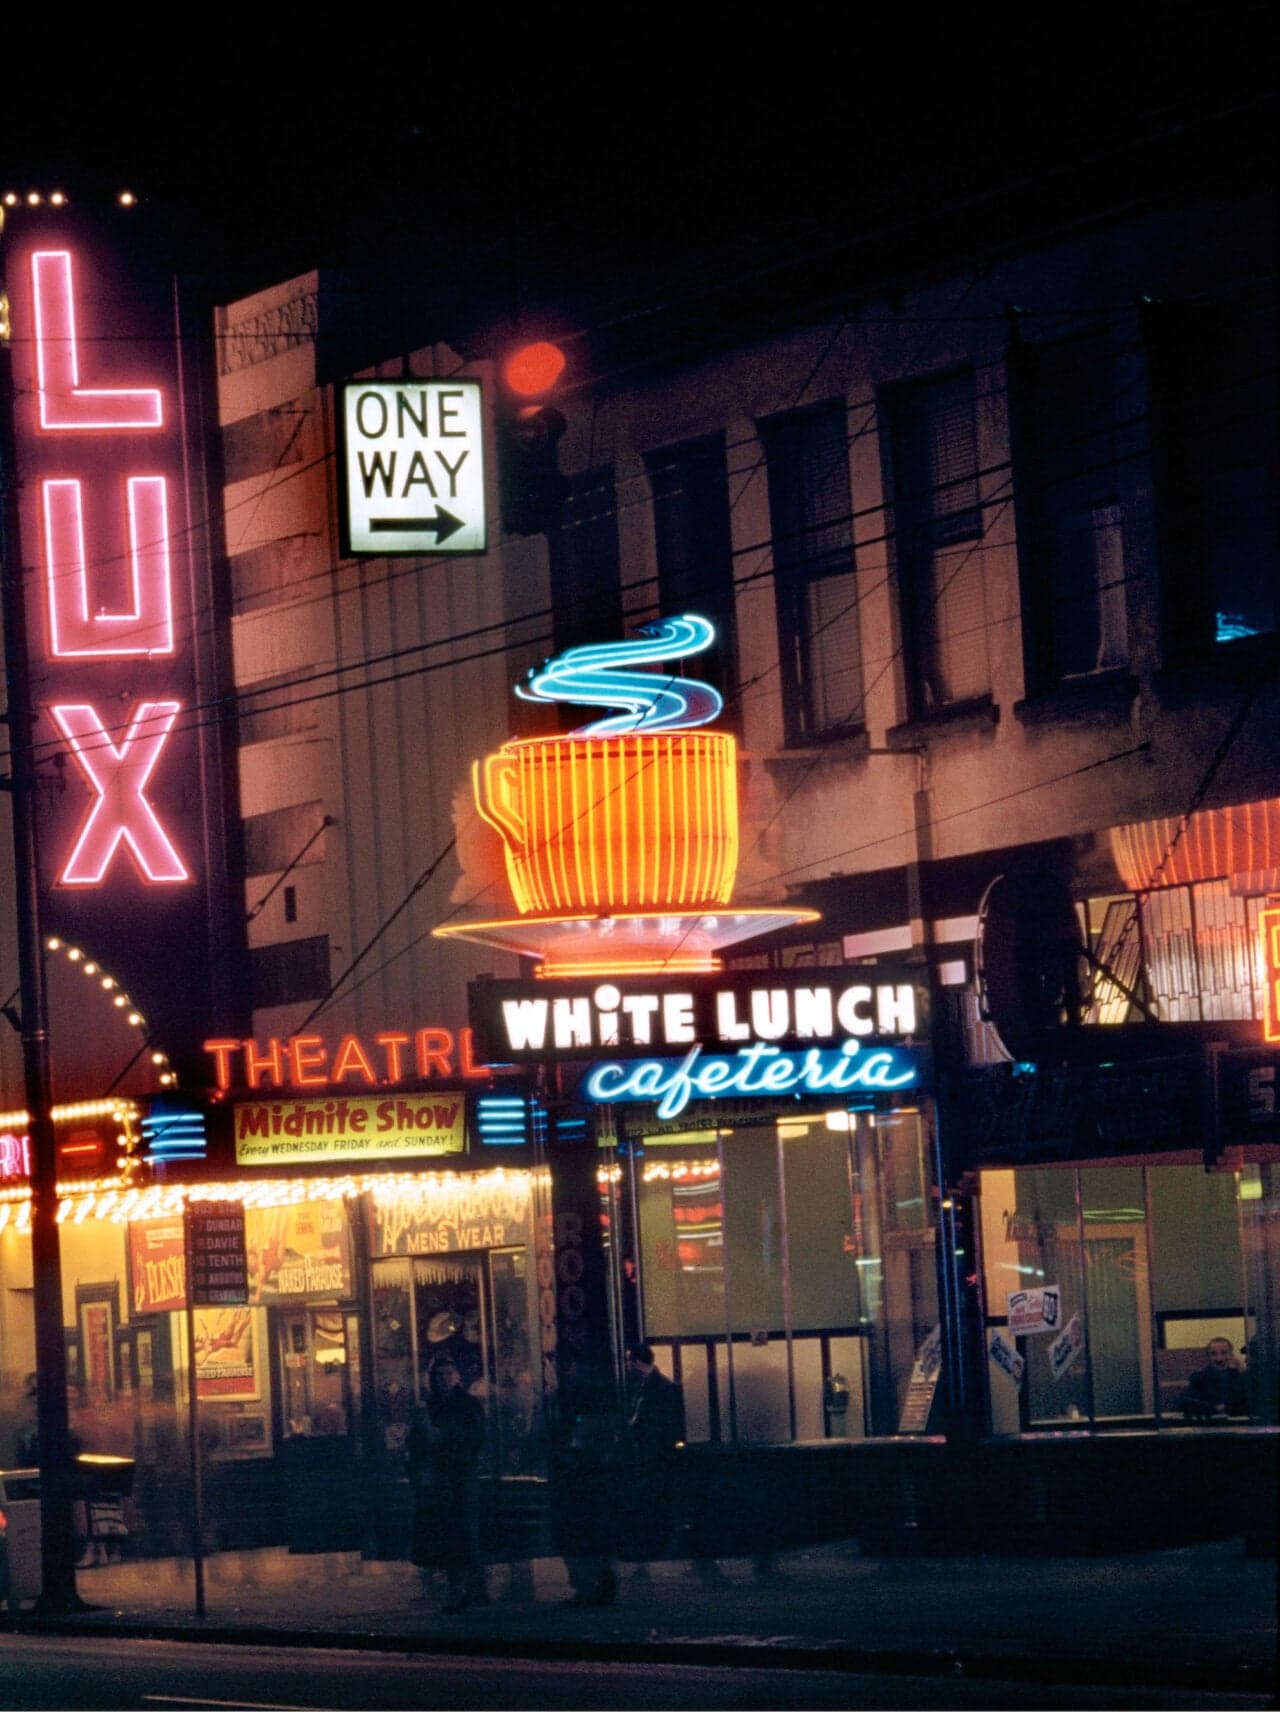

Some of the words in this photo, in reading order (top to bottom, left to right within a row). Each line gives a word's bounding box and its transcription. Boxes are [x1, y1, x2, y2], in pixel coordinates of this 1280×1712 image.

[356, 391, 466, 440] ONE
[358, 450, 470, 499] WAY
[30, 250, 189, 884] LUX
[717, 983, 917, 1043] LUNCH
[586, 1040, 917, 1119] cafeteria
[240, 1101, 368, 1140] Midnite
[376, 1101, 460, 1132] Show
[239, 1143, 270, 1157] Every
[272, 1141, 329, 1153] WEDNESDAY
[334, 1139, 371, 1150] FRIDAY
[206, 1219, 242, 1232] DUNBAR
[207, 1236, 239, 1250] DAVIE
[456, 1225, 506, 1247] WEAR
[208, 1254, 243, 1267] TENTH
[278, 1269, 305, 1293] NAKED
[305, 1254, 345, 1292] PARADISE
